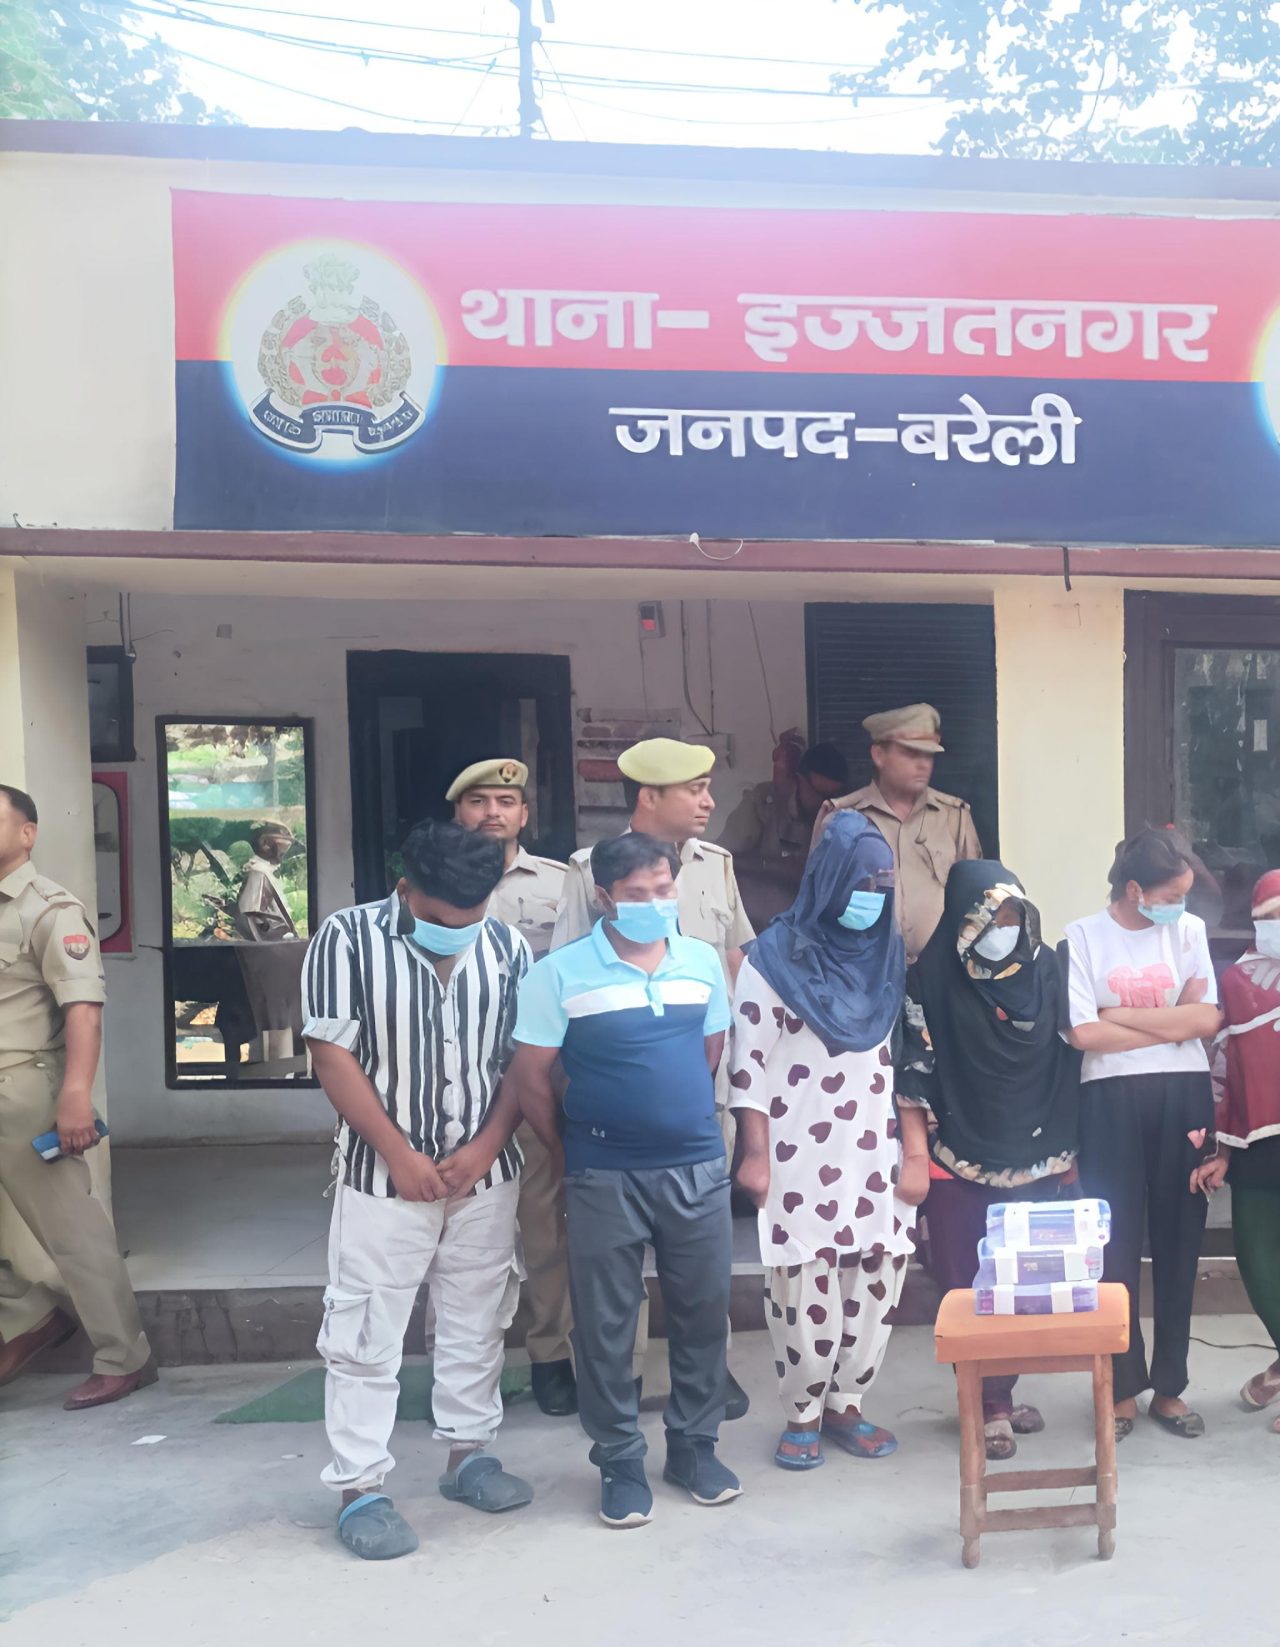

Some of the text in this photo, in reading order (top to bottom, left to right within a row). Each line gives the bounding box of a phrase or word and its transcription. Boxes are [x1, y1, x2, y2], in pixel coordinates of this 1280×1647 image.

[461, 288, 1218, 363] थाना- इज्जतनगर
[608, 393, 1083, 466] जनपद-बरेली
